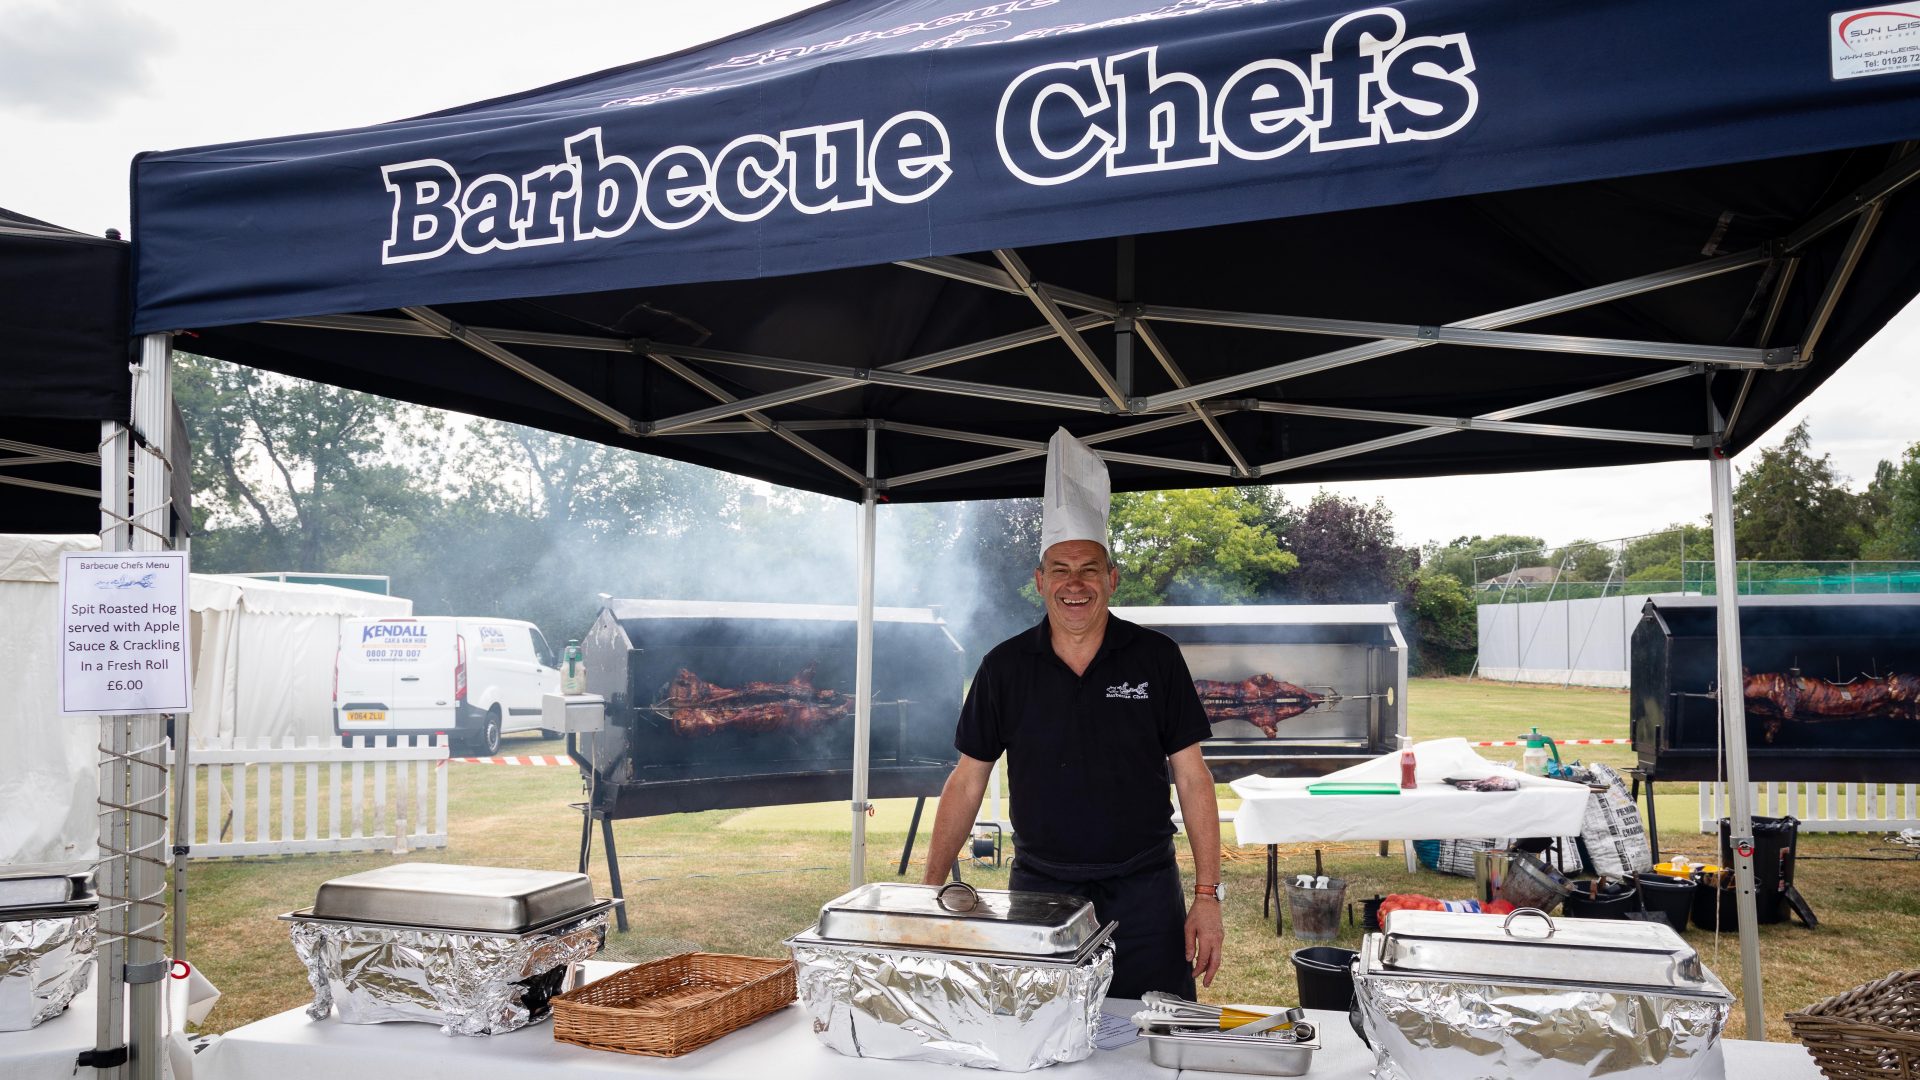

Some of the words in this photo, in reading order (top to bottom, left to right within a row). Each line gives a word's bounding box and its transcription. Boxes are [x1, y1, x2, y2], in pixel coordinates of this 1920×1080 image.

[1850, 27, 1881, 37] SUN
[1864, 60, 1880, 68] Tel:
[1881, 55, 1908, 66] 01928
[380, 110, 953, 265] Barbecue
[995, 7, 1479, 186] Chefs
[80, 562, 119, 570] Barbecue
[145, 561, 170, 569] Menu
[71, 604, 95, 616] Spit
[99, 603, 148, 614] Roasted
[152, 603, 177, 615] Hog
[68, 622, 110, 633] served
[113, 622, 140, 632] with
[144, 621, 180, 633] Apple
[361, 625, 428, 643] KENDALL
[68, 641, 106, 651] Sauce
[109, 640, 120, 651] &
[123, 639, 180, 651] Crackling
[366, 649, 386, 657] 0800
[390, 649, 403, 657] 770
[406, 649, 421, 657] 007
[80, 661, 93, 671] In
[96, 663, 103, 671] a
[107, 660, 142, 671] Fresh
[145, 659, 169, 670] Roll
[107, 679, 143, 691] £6.00
